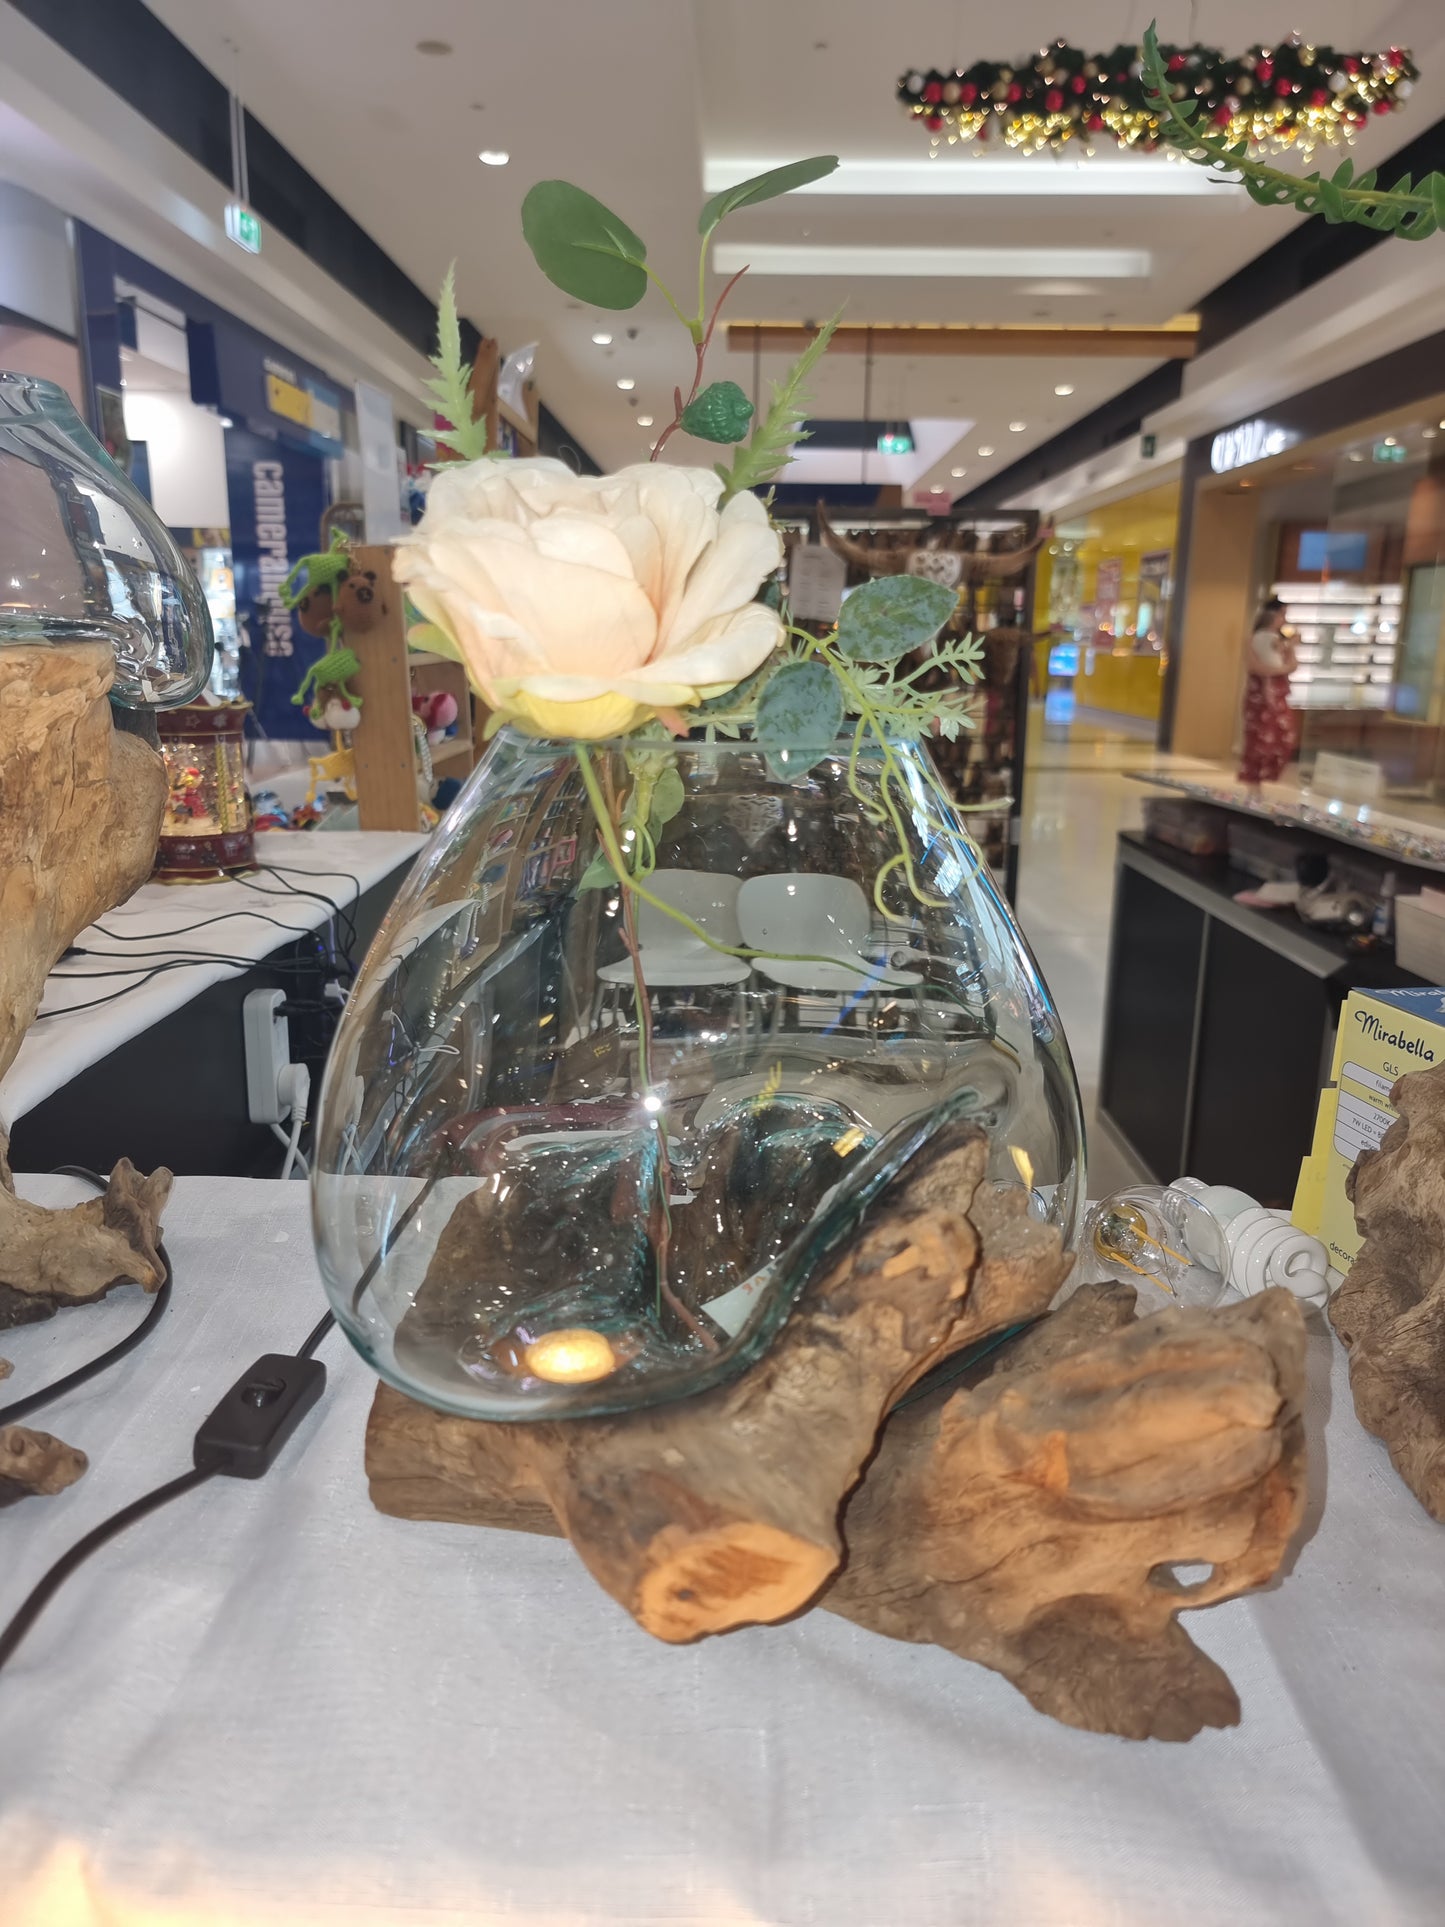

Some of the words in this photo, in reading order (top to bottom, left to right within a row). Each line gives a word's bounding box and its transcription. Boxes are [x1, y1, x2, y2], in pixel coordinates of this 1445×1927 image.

[1354, 1010, 1435, 1062] Mirabella
[1382, 1061, 1399, 1076] GLS
[1368, 1095, 1384, 1106] warm
[1362, 1122, 1373, 1133] LED
[1329, 1241, 1356, 1264] decora
